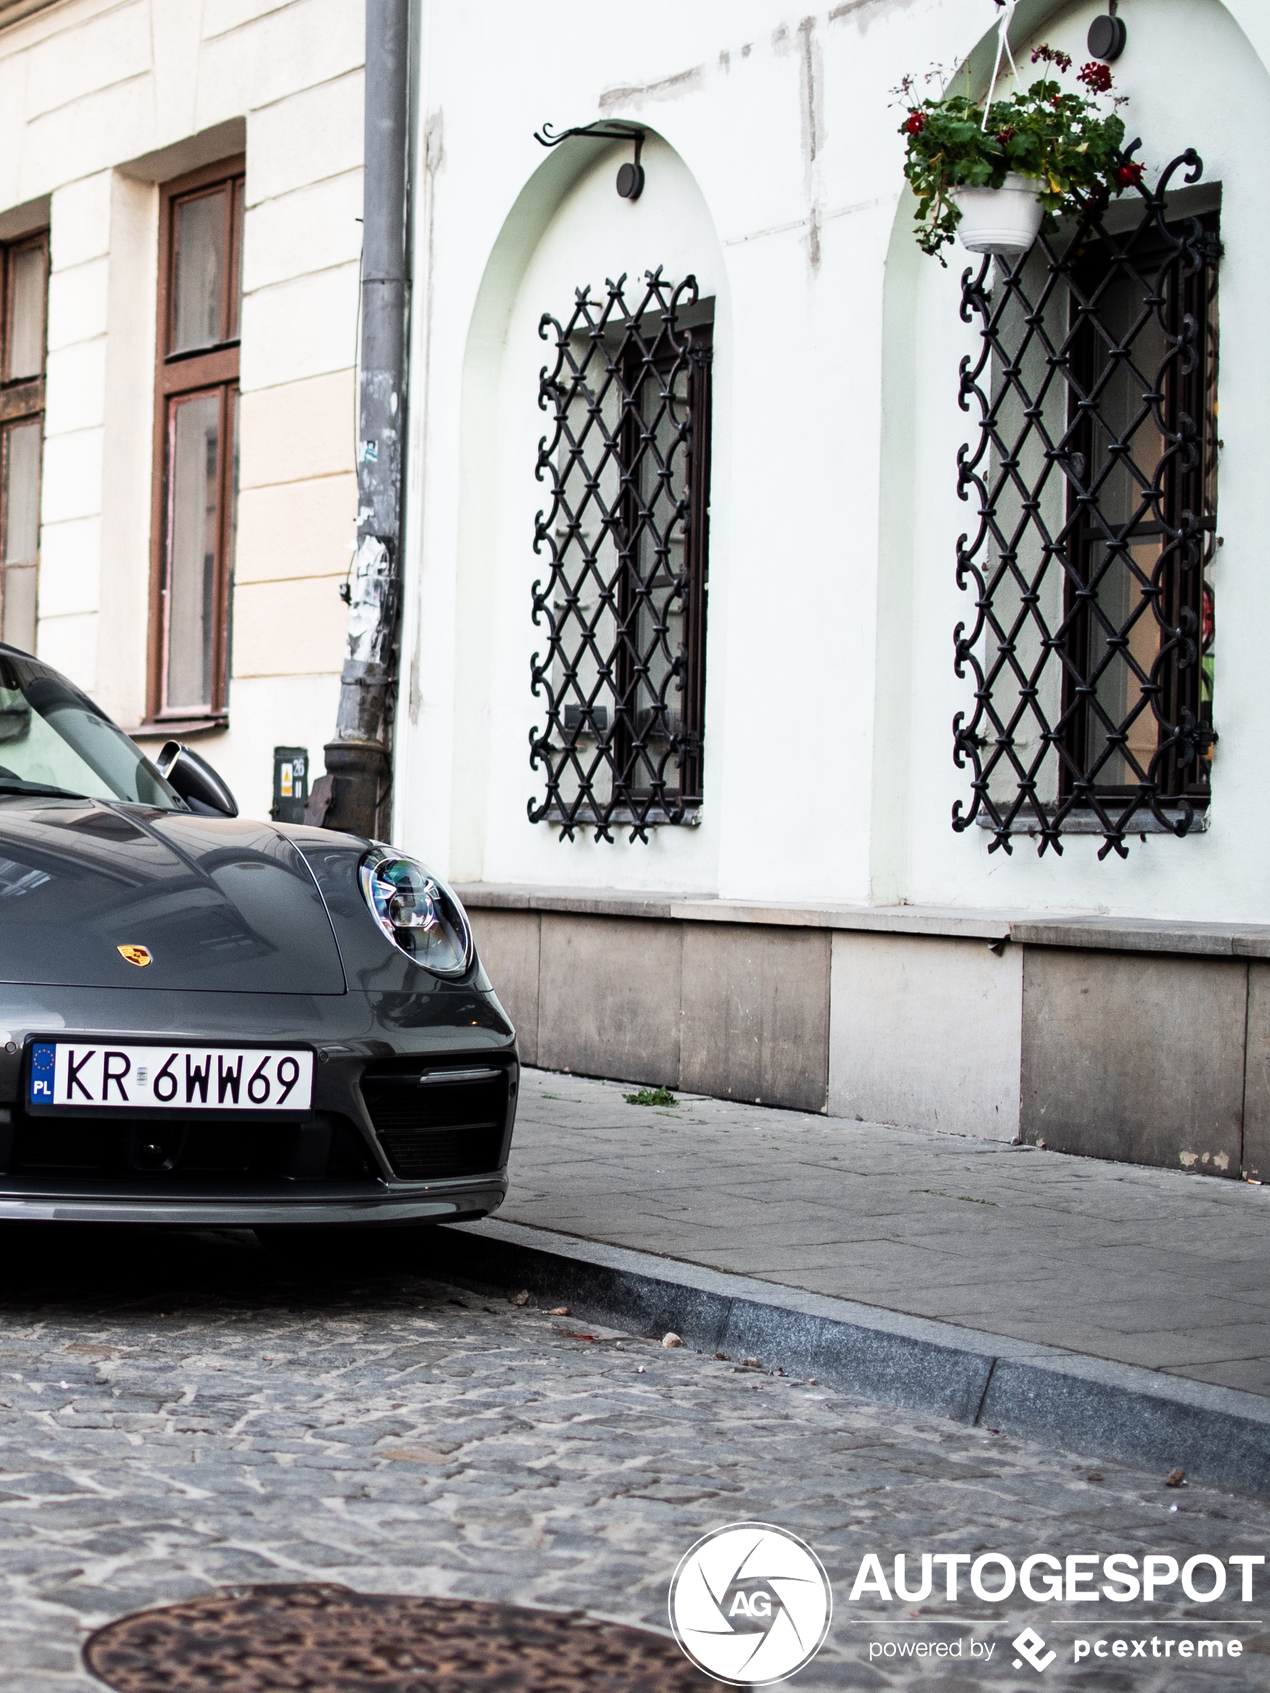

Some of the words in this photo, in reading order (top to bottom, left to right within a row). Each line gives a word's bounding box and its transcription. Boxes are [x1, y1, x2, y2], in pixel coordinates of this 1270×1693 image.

[33, 1080, 52, 1096] PL
[66, 1050, 131, 1101] KR
[153, 1053, 300, 1105] 6WW69
